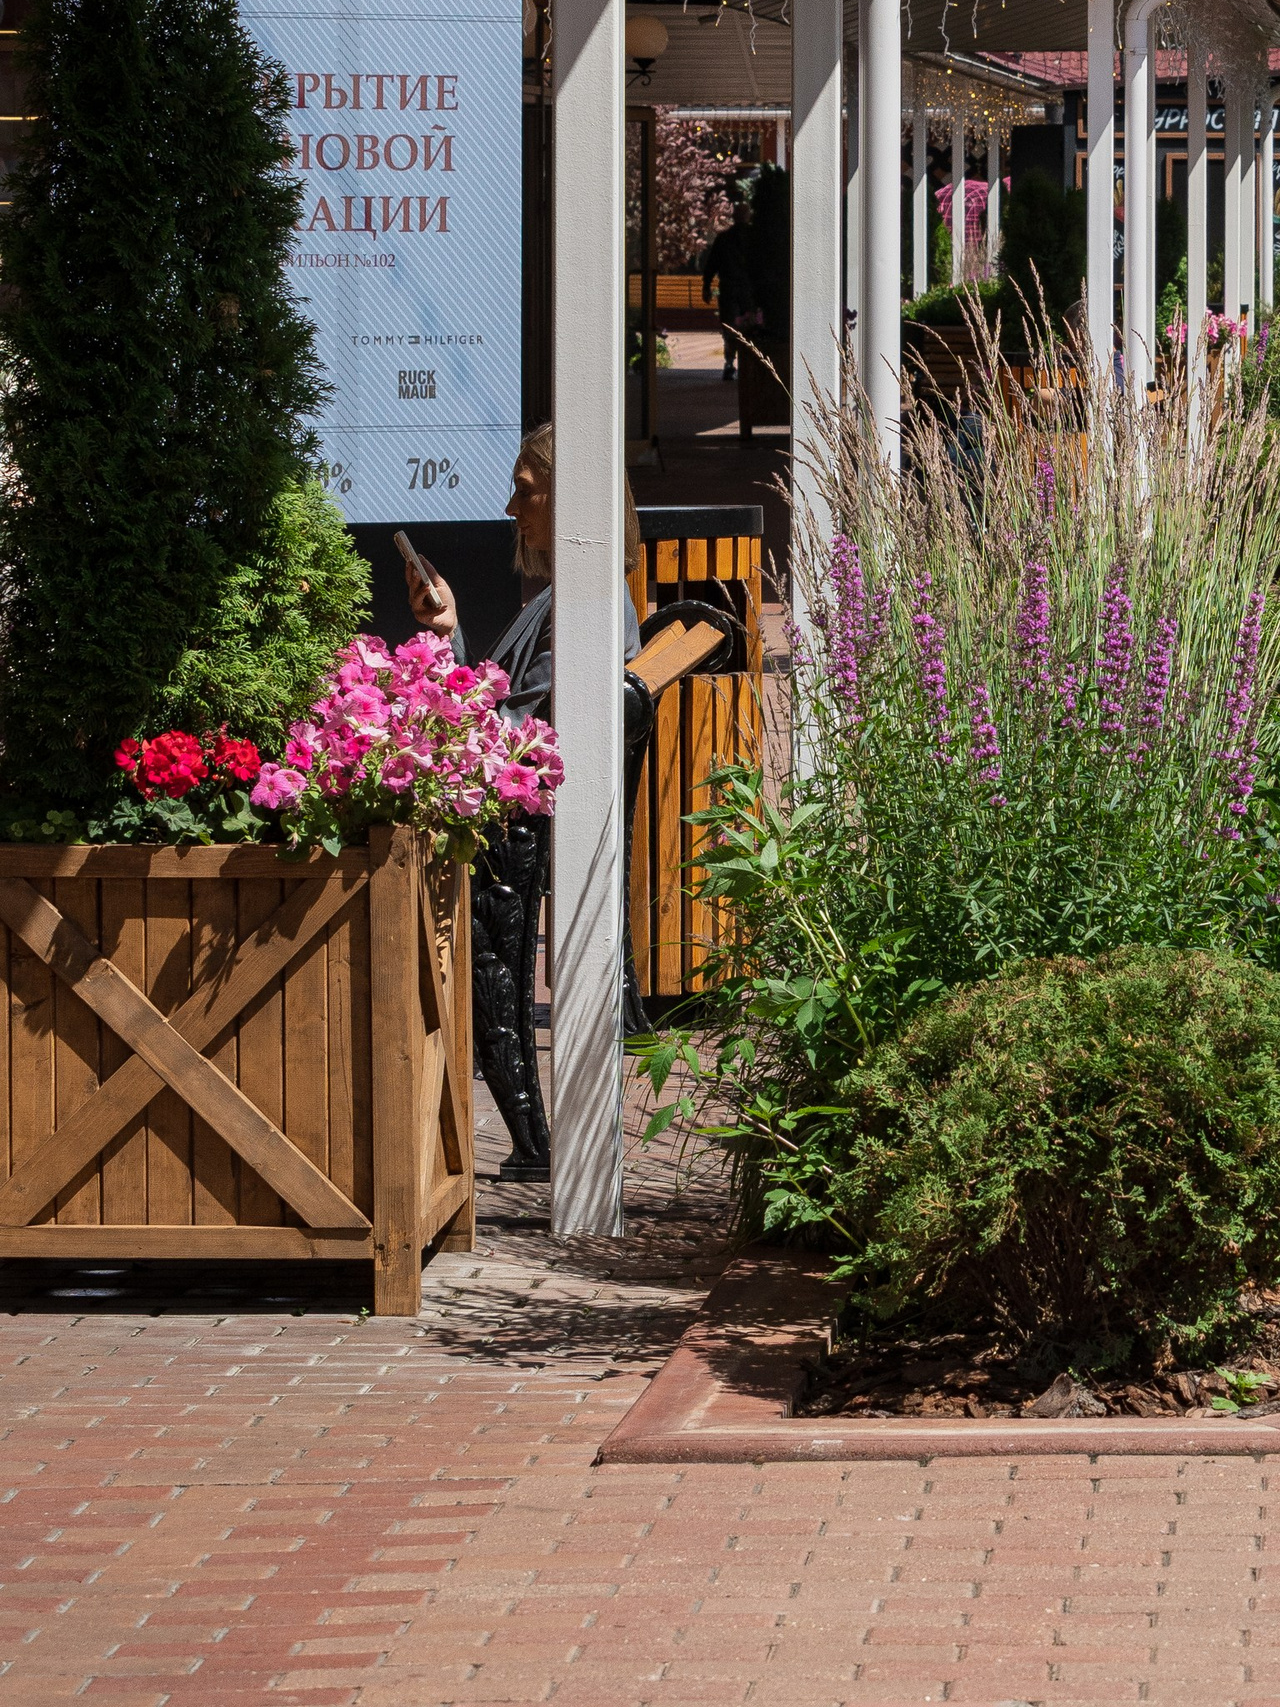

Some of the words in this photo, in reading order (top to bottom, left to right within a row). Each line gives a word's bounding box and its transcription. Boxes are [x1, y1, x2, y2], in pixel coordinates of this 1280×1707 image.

[264, 73, 459, 111] РЫТИЕ
[281, 124, 456, 172] НОВОЙ
[354, 253, 396, 268] №102
[351, 335, 405, 346] TOMMY
[424, 334, 484, 345] HILFIGER
[398, 370, 437, 385] RUCK
[406, 457, 460, 490] 70%
